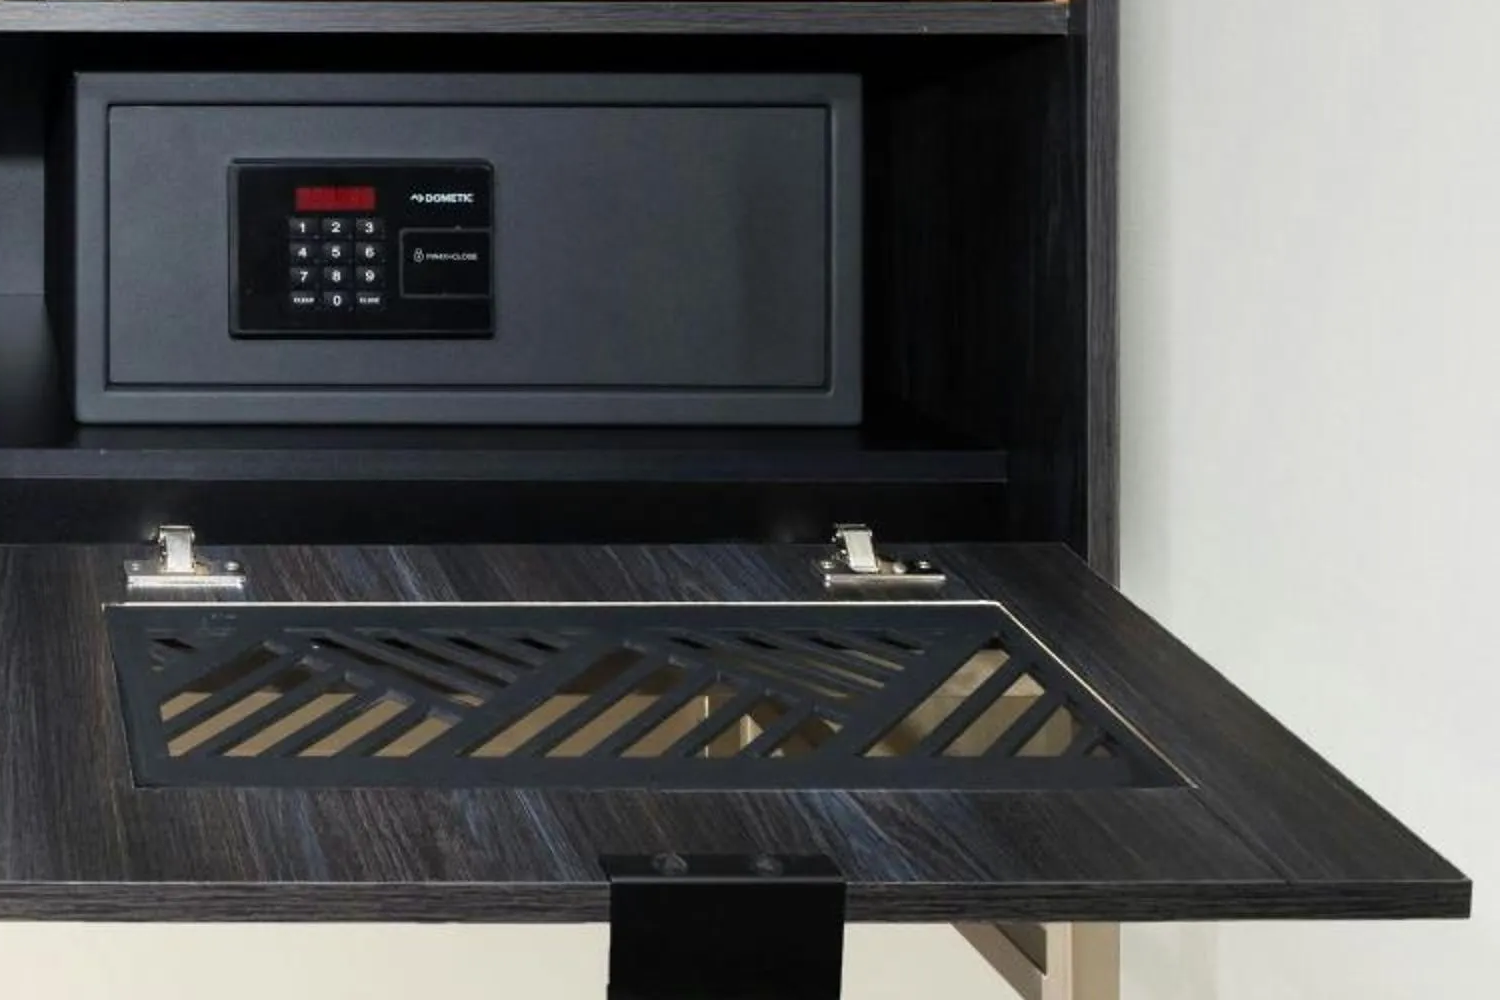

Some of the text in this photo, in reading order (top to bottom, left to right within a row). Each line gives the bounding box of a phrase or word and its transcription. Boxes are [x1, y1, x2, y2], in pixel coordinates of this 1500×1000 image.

[425, 193, 475, 203] DOMETIC
[331, 221, 341, 233] 2
[365, 221, 374, 234] 3
[297, 245, 376, 258] 4 5 6
[300, 269, 375, 283] 7 8 9
[332, 294, 342, 307] 0
